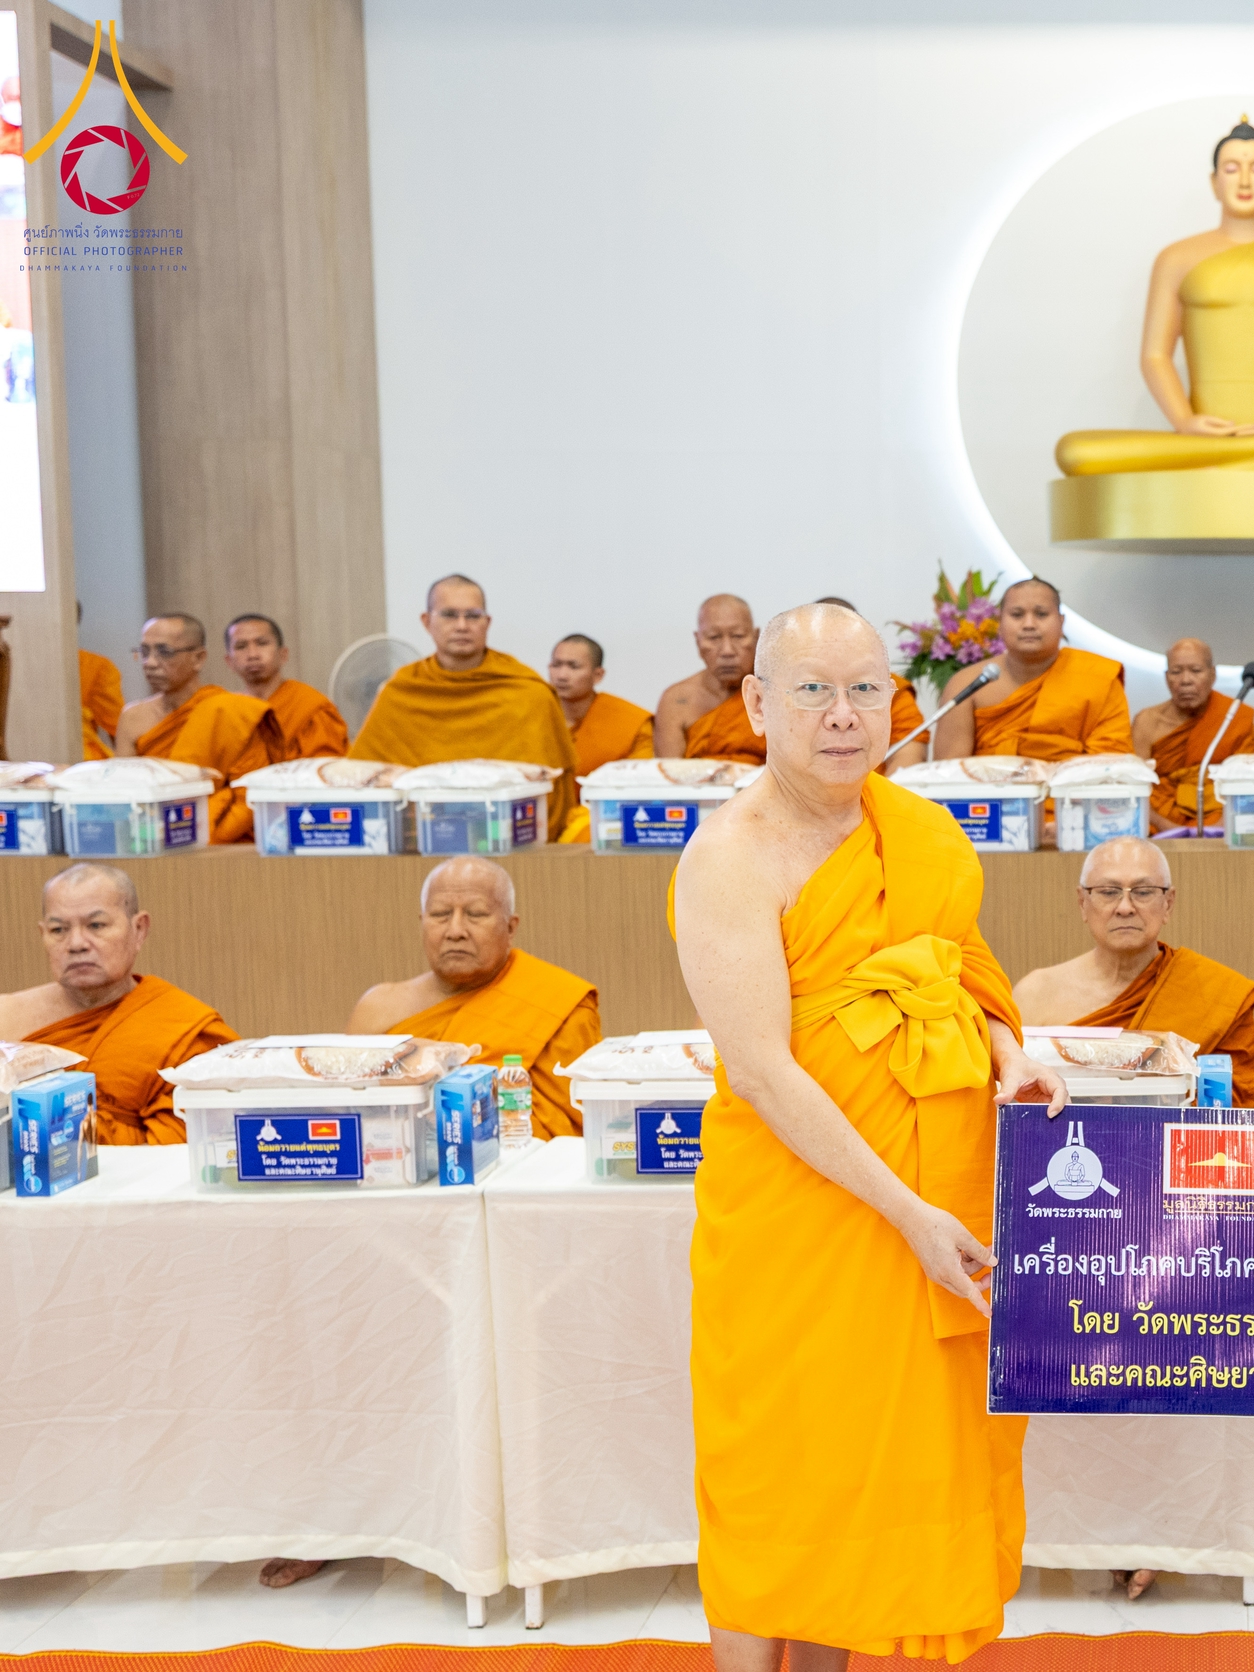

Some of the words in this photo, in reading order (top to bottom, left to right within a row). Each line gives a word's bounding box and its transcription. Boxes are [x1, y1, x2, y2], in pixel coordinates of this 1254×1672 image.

[1026, 1203, 1122, 1218] วัดพระธรรมกาย
[1069, 1299, 1119, 1335] โดย
